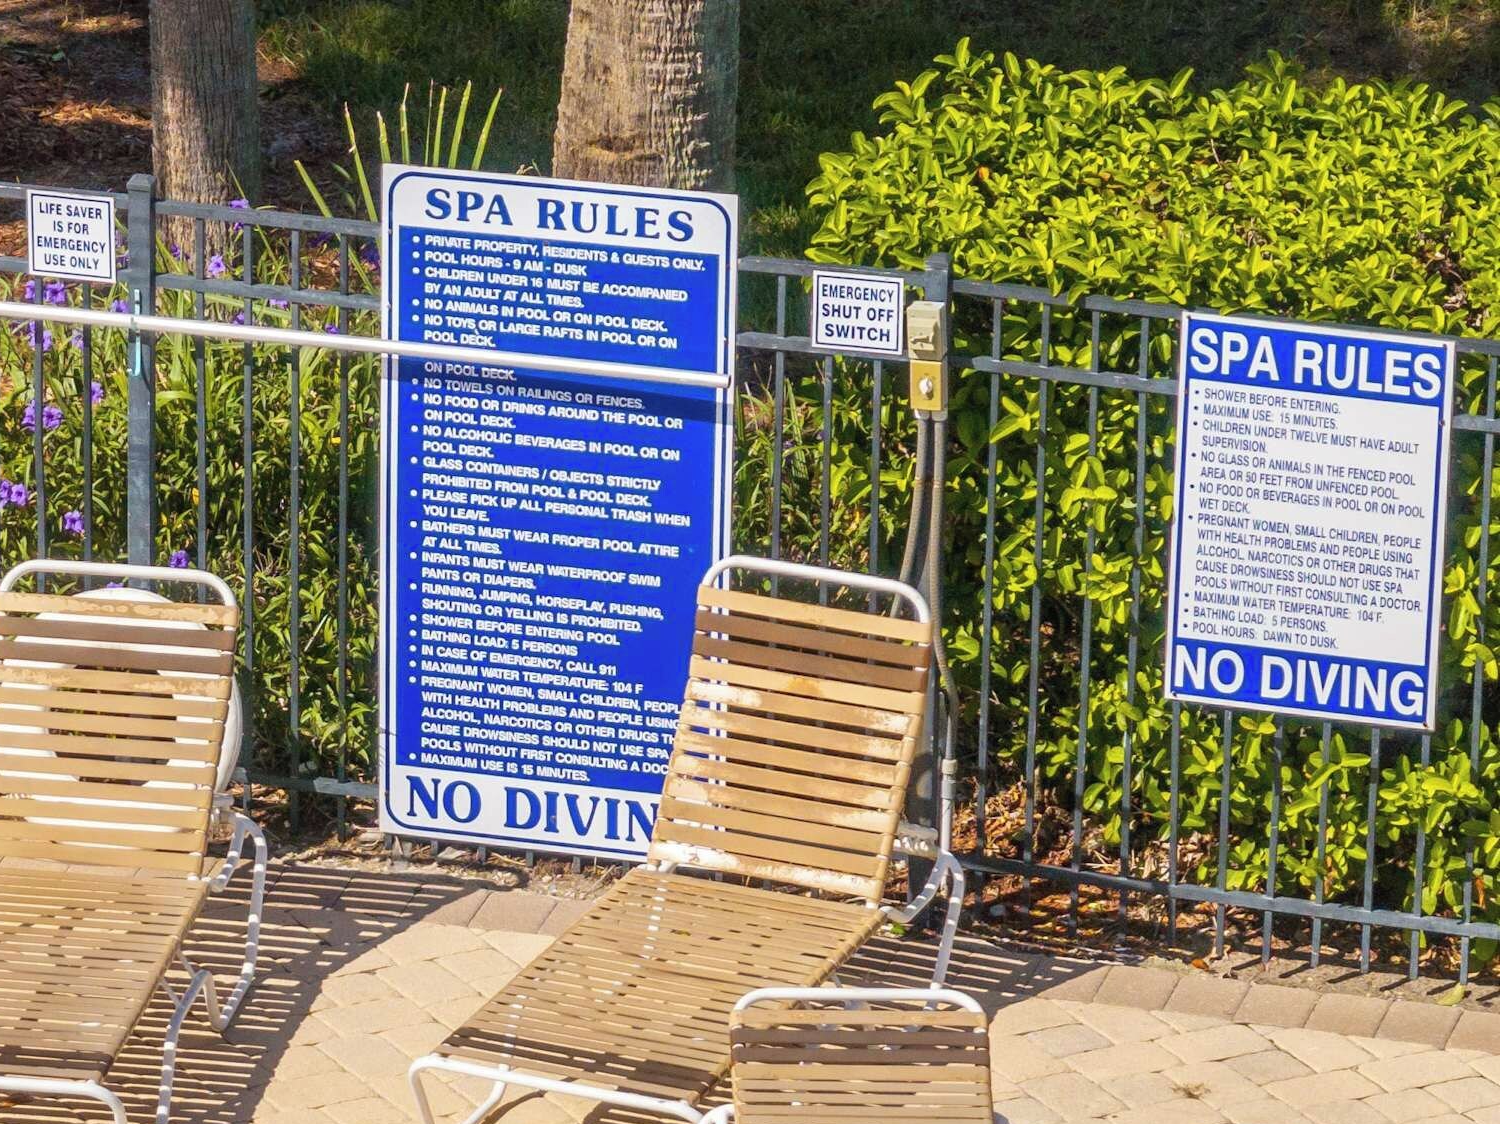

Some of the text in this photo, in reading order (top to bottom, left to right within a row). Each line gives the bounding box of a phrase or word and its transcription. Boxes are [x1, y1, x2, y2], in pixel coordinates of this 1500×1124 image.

[39, 202, 102, 220] LIFE SAVER
[53, 220, 89, 235] IS FOR
[425, 188, 695, 242] SPA RULES
[37, 236, 106, 254] EMERGENCY
[44, 253, 100, 270] USE ONLY
[424, 234, 705, 270] PRIVATE PROPERTY, RESIDENTS & GUESTS ONLY.
[424, 266, 688, 301] CHILDREN UNDER 16 MUST BE ACCOMPANIED
[424, 282, 584, 308] BY AN ADULT AT ALL TIMES.
[822, 284, 894, 303] EMERGENCY
[423, 297, 667, 331] NO ANIMALS IN POOL OR ON POOL DECK.
[822, 303, 894, 322] SHUT OFF
[824, 323, 890, 342] SWITCH
[1190, 328, 1442, 400] SPA RULES
[423, 392, 682, 429] NO FOOD OR DRINKS AROUND THE POOL OR
[1204, 387, 1246, 402] SHOWER
[1248, 392, 1287, 408] BEFORE
[1202, 418, 1419, 454] CHILDREN UNDER TWELVE MUST HAVE ADULT
[1199, 466, 1226, 479] AREA
[1228, 469, 1243, 481] OR
[1245, 471, 1257, 483] 50
[1259, 472, 1283, 486] FEET
[1284, 475, 1313, 489] FROM
[1315, 479, 1368, 496] UNFENCED
[1200, 450, 1415, 486] NO GLASS OR ANIMALS IN THE FENCED POOL
[422, 488, 690, 526] PLEASE PICK UP ALL PERSONAL TRASH WHEN
[1198, 496, 1219, 510] WET
[421, 520, 679, 557] BATHERS MUST WEAR PROPER POOL ATTIRE
[1197, 527, 1412, 564] WITH HEALTH PROBLEMS AND PEOPLE USING
[421, 551, 660, 586] INFANTS MUST WEAR WATERPROOF SWIM
[421, 566, 536, 589] PANTS OR DIAPERS.
[1195, 559, 1403, 594] CAUSE DROWSINESS SHOULD NOT USE SPA
[421, 582, 663, 618] RUNNING, JUMPING, HORSEPLAY, PUSHING,
[421, 598, 642, 631] SHOUTING OR YELLING IS PROHIBITED.
[421, 613, 620, 645] SHOWER BEFORE ENTERING POOL
[421, 629, 578, 656] BATHING LOAD: 5 PERSONS
[1192, 621, 1219, 635] POOL
[1262, 629, 1292, 643] DAWN
[1294, 632, 1307, 645] TO
[421, 644, 616, 676] IN CASE OF EMERGENCY, CALL 911
[420, 660, 643, 694] MAXIMUM WATER TEMPERATURE: 104 F
[1174, 644, 1424, 716] NO DIVING
[420, 752, 590, 781] MAXIMUM USE IS 15 MINUTES.
[406, 775, 659, 843] NO DIVIN
